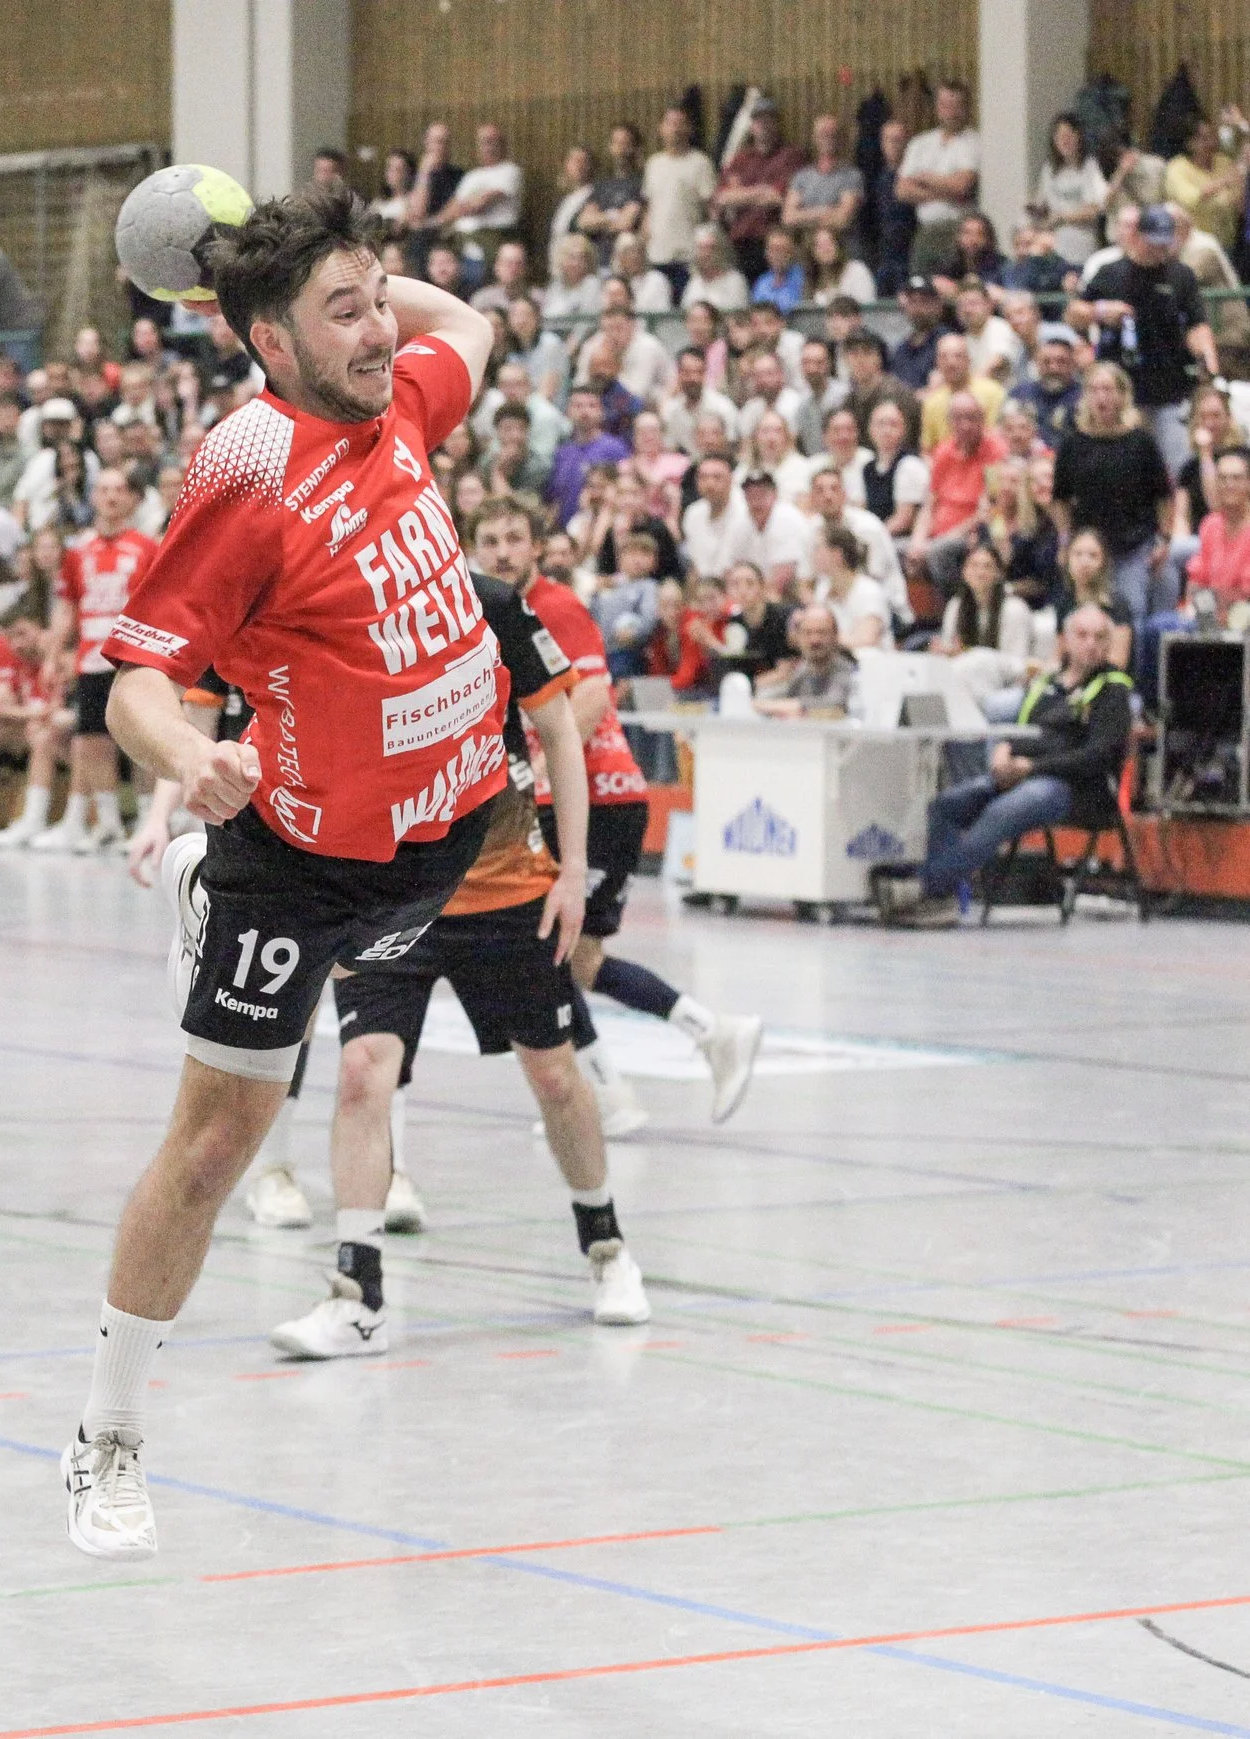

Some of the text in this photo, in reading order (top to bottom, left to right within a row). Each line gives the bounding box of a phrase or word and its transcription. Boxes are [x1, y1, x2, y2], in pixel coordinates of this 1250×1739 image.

[284, 453, 337, 512] STENDER
[300, 480, 355, 525] Kempa
[386, 668, 491, 730] Fischbach
[232, 928, 300, 995] 19
[214, 988, 279, 1021] Kempa
